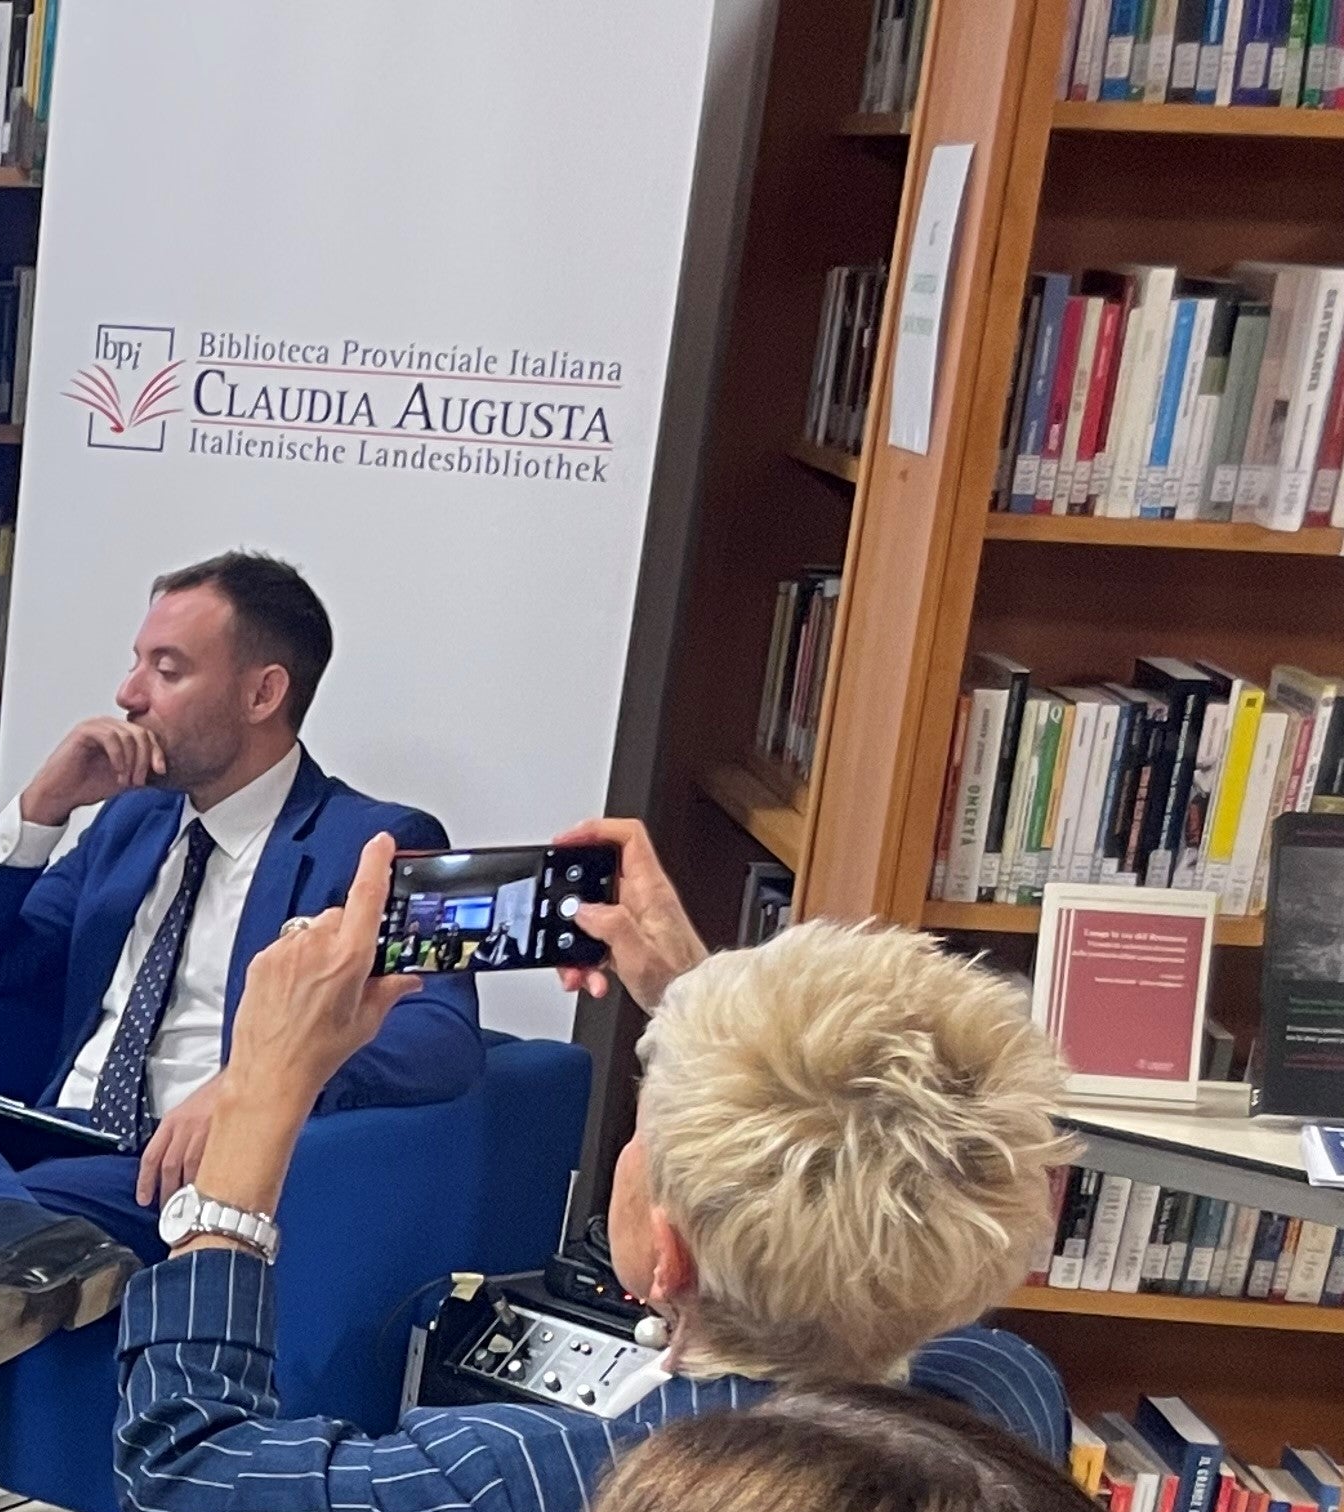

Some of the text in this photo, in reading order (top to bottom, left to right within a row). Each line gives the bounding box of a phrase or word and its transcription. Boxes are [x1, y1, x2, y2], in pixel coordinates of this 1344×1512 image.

[199, 332, 622, 382] Biblioteca Provinciale Italiana
[193, 369, 612, 443] CLAUDIA AUGUSTA
[189, 429, 607, 483] Italienische Landesbibliothek
